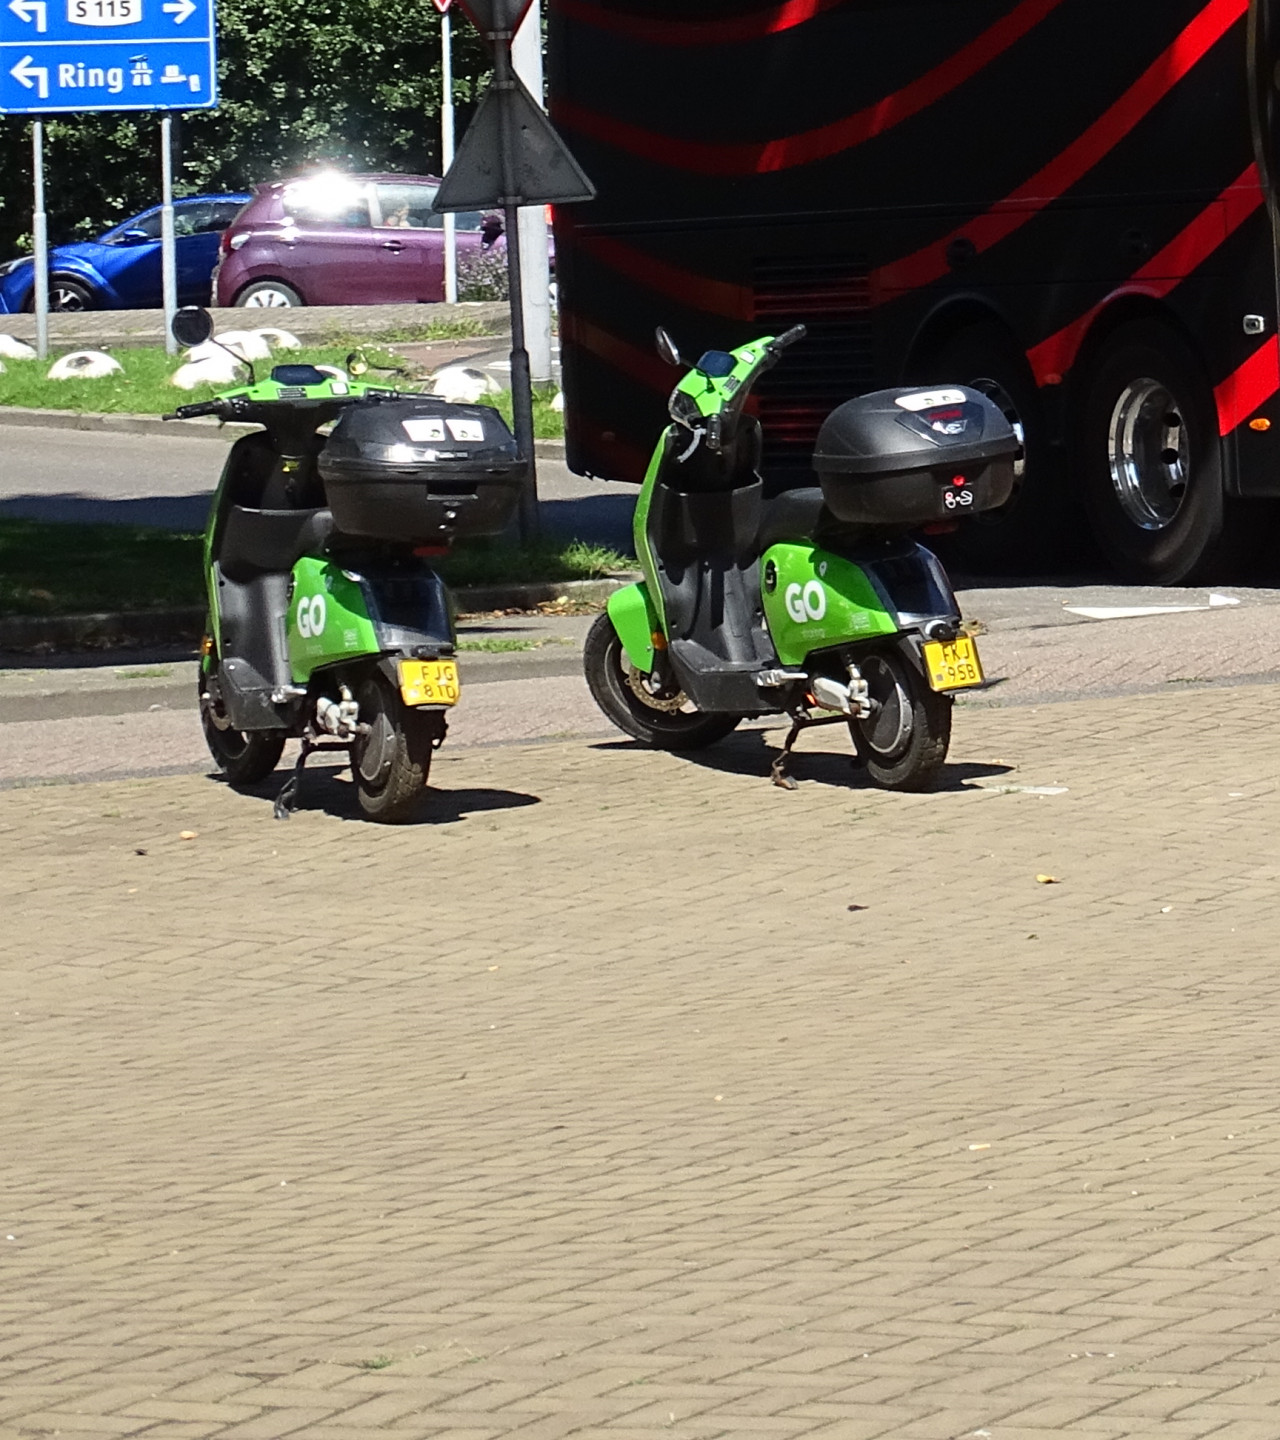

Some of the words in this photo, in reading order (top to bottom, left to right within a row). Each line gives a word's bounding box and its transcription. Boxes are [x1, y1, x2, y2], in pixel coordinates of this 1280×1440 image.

[75, 0, 87, 18] S
[94, 0, 131, 18] 115
[58, 62, 123, 94] Ring
[297, 594, 326, 639] GO
[785, 580, 827, 624] GO
